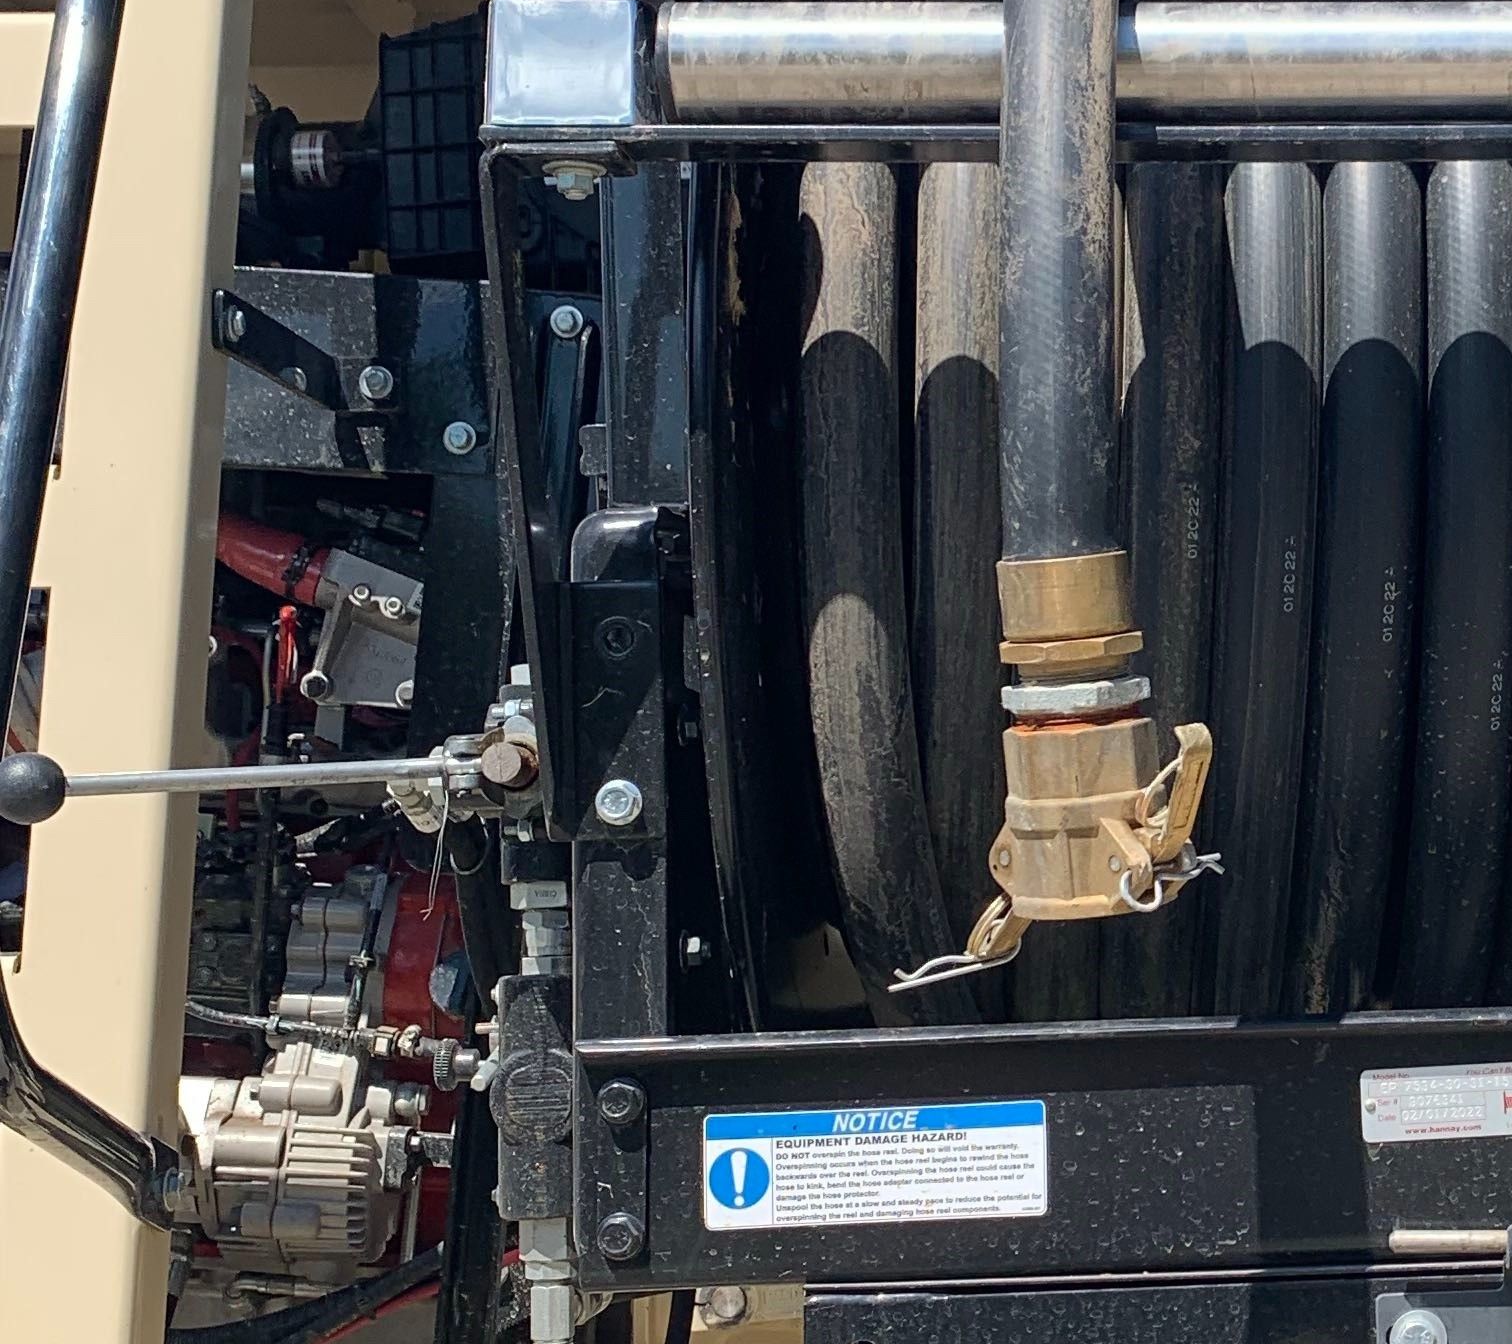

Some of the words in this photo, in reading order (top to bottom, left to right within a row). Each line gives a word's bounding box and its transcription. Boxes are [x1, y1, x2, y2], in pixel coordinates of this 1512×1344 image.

[1188, 497, 1200, 517] 22
[1187, 544, 1198, 559] 01
[1284, 551, 1296, 570] 22
[1384, 581, 1396, 601] 22
[1283, 597, 1294, 612] 01
[1382, 627, 1393, 642] 01
[1491, 673, 1503, 691] 22
[1490, 716, 1501, 731] 01
[832, 1110, 918, 1132] NOTICE
[776, 1137, 850, 1148] EQUIPMENT
[855, 1135, 907, 1145] DAMAGE
[912, 1132, 966, 1142] HAZARD!
[901, 1147, 924, 1156] Doing
[775, 1161, 827, 1171] Overspinning
[931, 1156, 957, 1165] begins
[969, 1154, 994, 1162] rewind
[871, 1167, 922, 1177] Overspinning
[775, 1193, 806, 1202] damage
[775, 1203, 808, 1212] Unspool
[897, 1198, 923, 1207] steady
[997, 1194, 1029, 1203] potential
[875, 1209, 913, 1218] damaging
